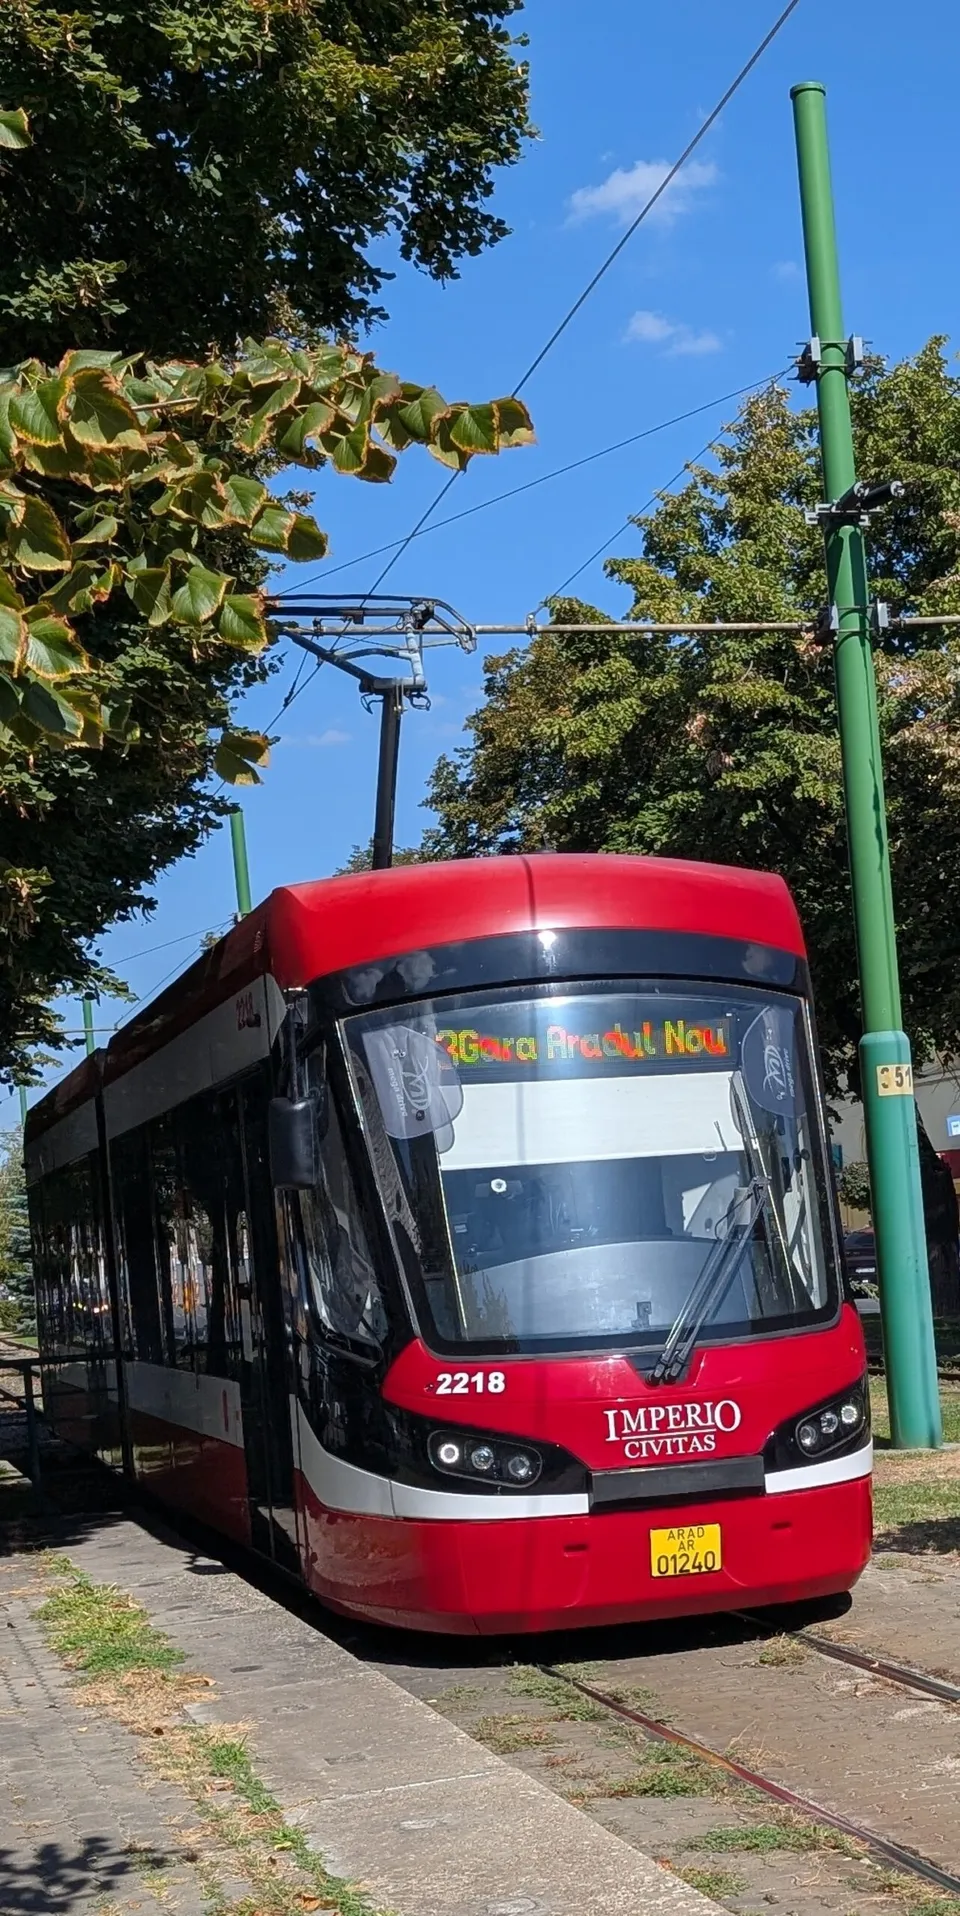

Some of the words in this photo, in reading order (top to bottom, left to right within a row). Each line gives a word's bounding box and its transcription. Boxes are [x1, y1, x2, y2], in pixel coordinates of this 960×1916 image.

[546, 1022, 656, 1060] Aradul
[664, 1020, 727, 1056] Nou
[436, 1371, 505, 1394] 2218
[603, 1400, 742, 1441] IMPERIO
[624, 1434, 716, 1458] CIVITAS
[667, 1526, 705, 1540] ARAD
[678, 1540, 695, 1552] AR
[657, 1551, 716, 1575] 01240
